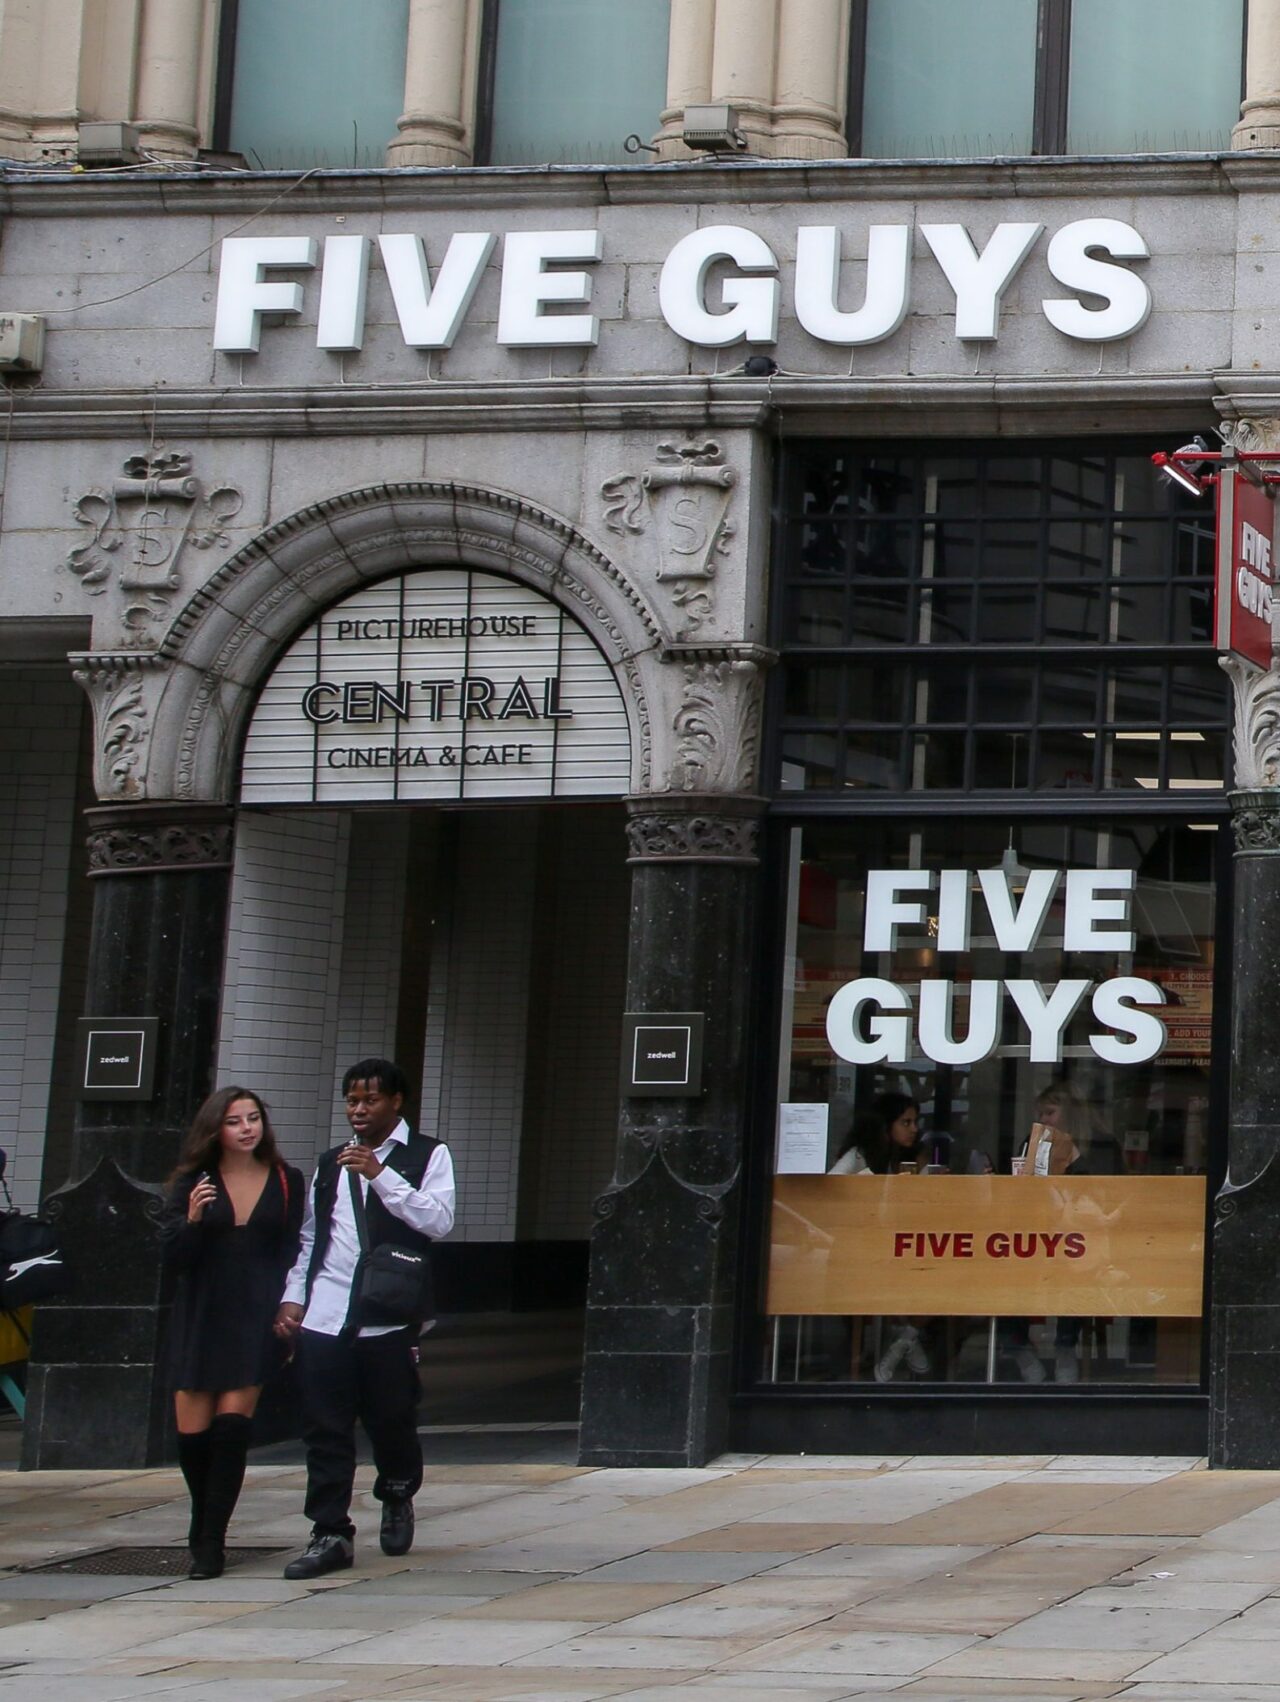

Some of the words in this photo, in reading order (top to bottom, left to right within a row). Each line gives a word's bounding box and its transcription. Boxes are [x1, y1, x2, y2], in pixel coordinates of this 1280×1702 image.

[213, 229, 603, 353] FIVE
[659, 217, 1153, 347] GUYS
[1241, 521, 1271, 578] FIVE
[1237, 566, 1273, 625] GUYS
[337, 616, 537, 641] PICTUREHOUSE
[301, 674, 574, 726] CENTRAL
[327, 746, 429, 769] CINEMA
[438, 745, 457, 767] &
[462, 744, 534, 767] CAFE
[863, 869, 1137, 953] FIVE
[825, 976, 1168, 1065] GUYS
[99, 1055, 130, 1064] zedwell
[646, 1051, 677, 1060] zedwell
[893, 1232, 974, 1259] FIVE
[984, 1232, 1087, 1259] GUYS
